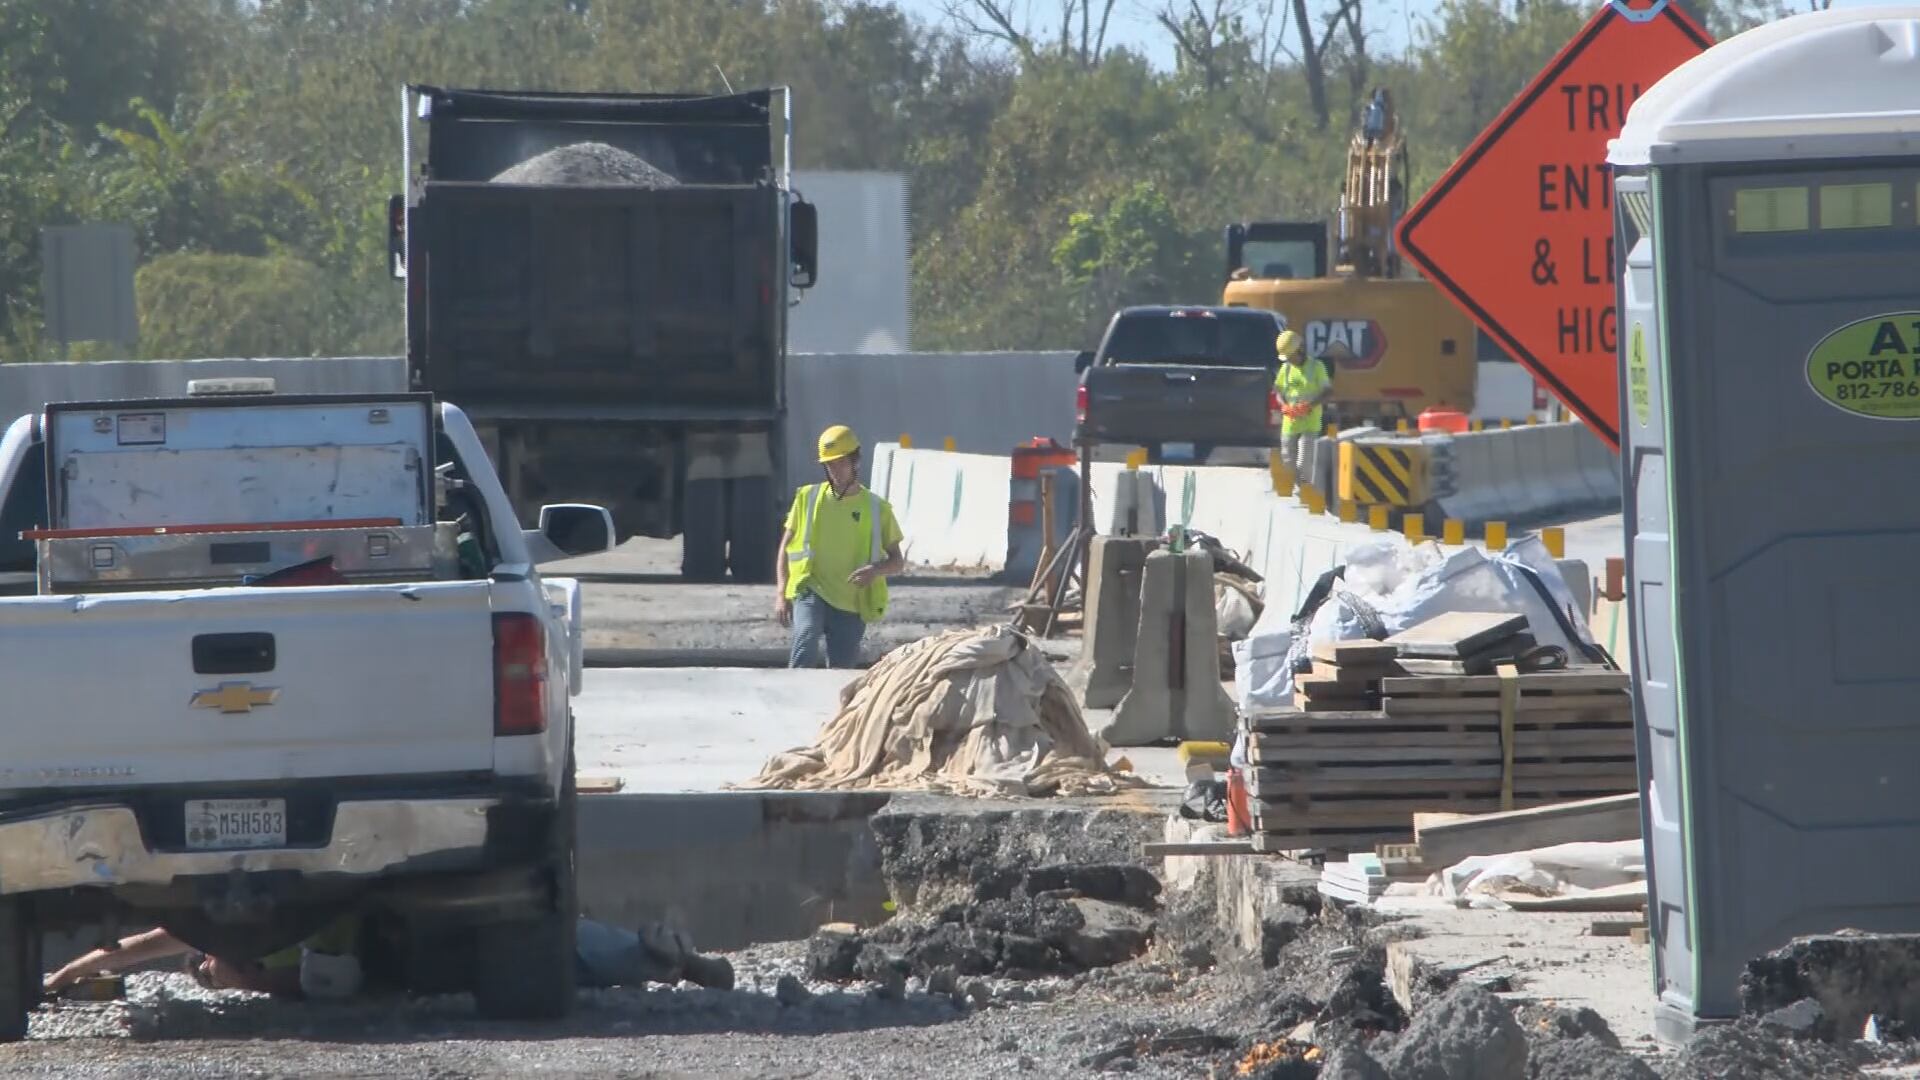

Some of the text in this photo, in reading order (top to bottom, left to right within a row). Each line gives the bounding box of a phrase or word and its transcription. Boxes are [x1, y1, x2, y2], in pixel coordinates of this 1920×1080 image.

[1539, 164, 1613, 211] ENT
[1532, 238, 1558, 285] &
[1305, 320, 1368, 358] CAT
[1557, 306, 1617, 353] HIG
[1826, 359, 1905, 381] PORTA
[219, 811, 283, 835] M5H583
